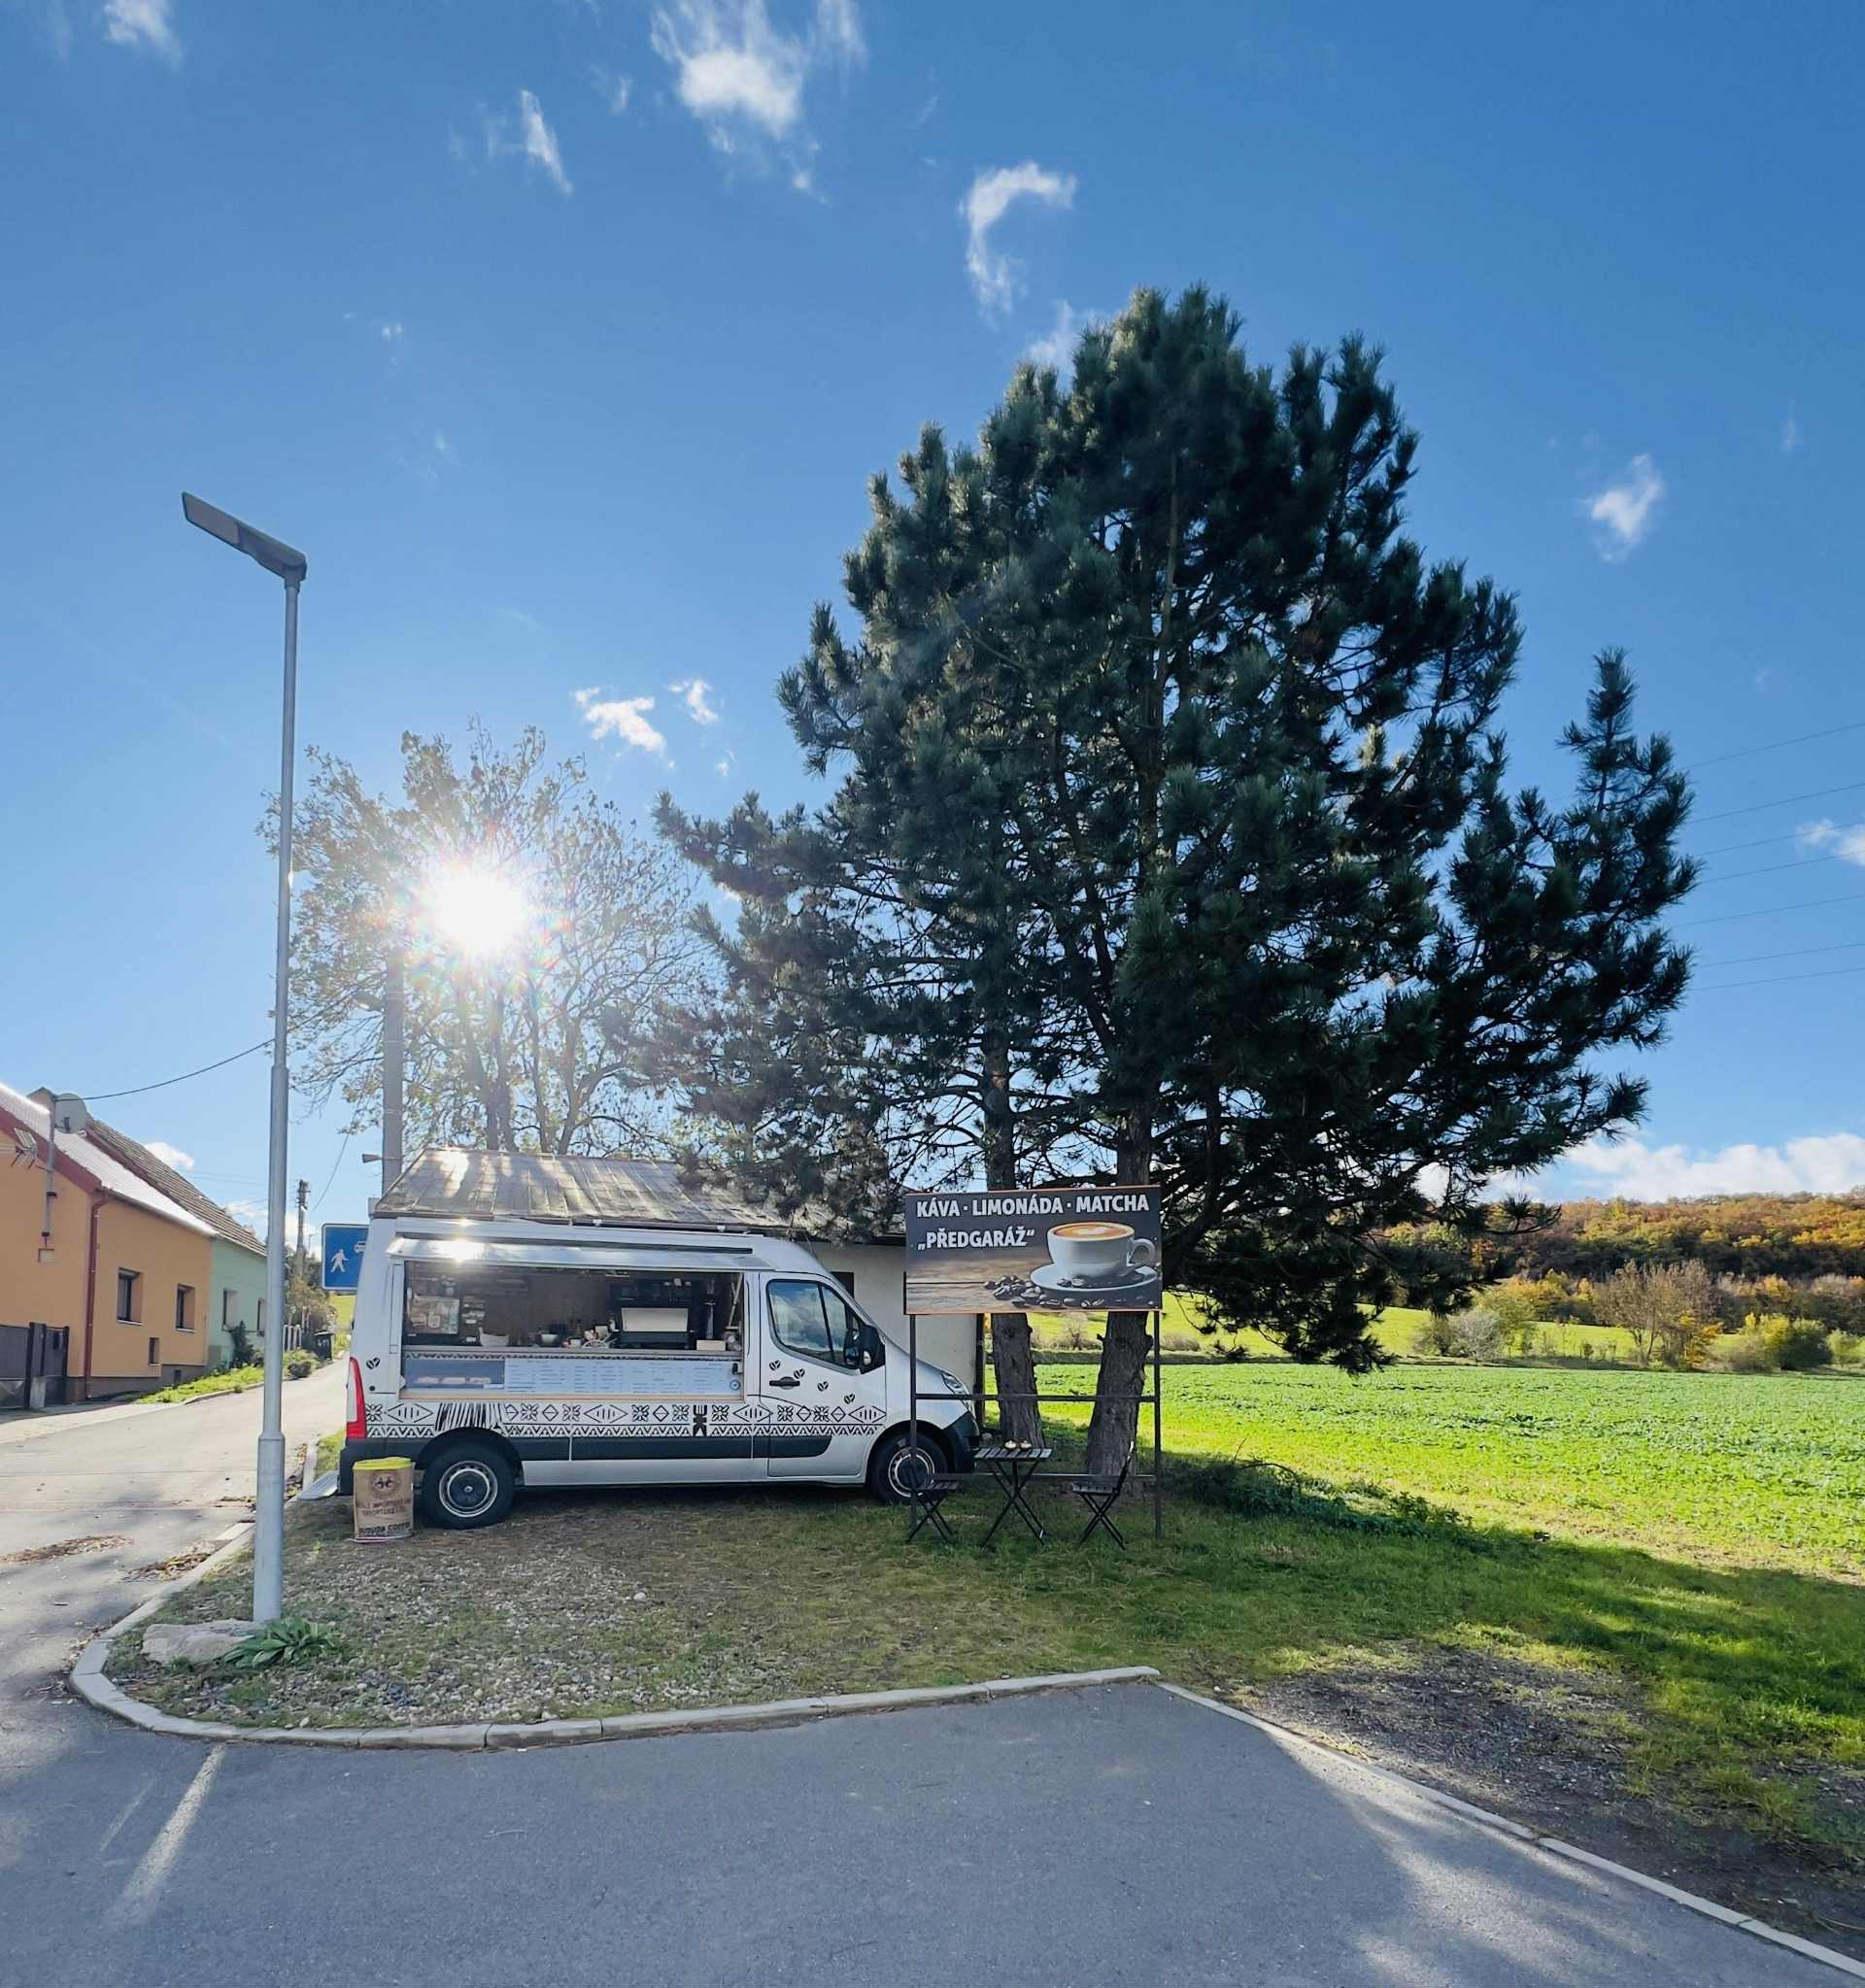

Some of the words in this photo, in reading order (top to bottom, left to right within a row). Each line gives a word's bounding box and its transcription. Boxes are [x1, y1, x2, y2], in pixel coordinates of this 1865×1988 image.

[916, 1196, 961, 1218] KÁVA
[972, 1195, 1064, 1216] LIMONÁDA
[1075, 1195, 1150, 1213] MATCHA
